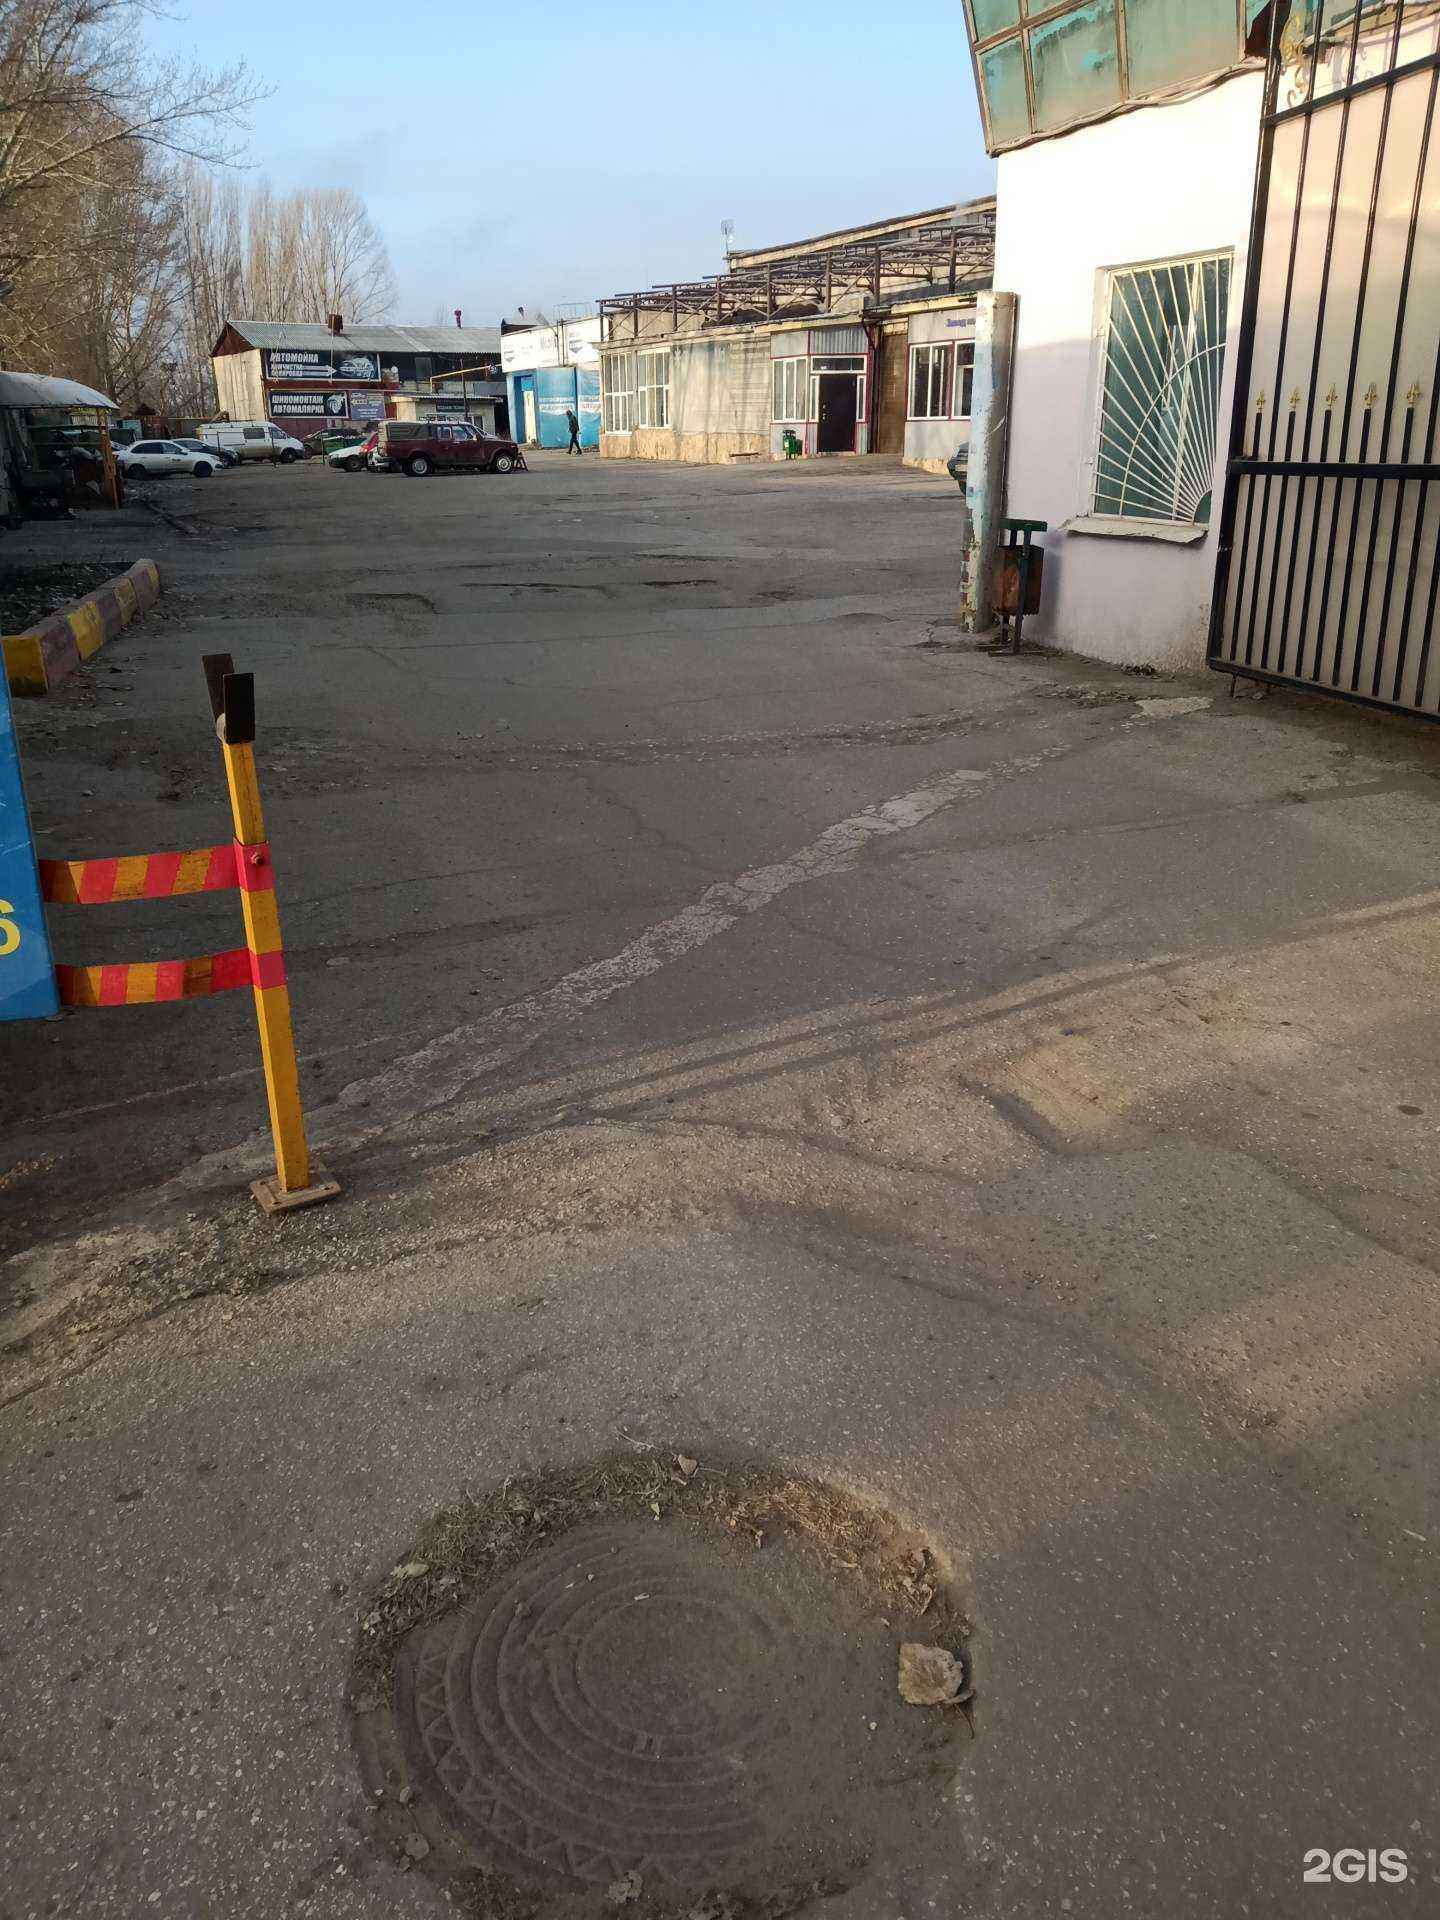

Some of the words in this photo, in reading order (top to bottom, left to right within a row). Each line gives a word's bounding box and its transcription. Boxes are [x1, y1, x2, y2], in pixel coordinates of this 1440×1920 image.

[270, 352, 319, 363] АВТОМОЙКА
[272, 395, 323, 404] ШИНОМОНТАЖ
[273, 404, 324, 413] АВТОМАЛЯРКА
